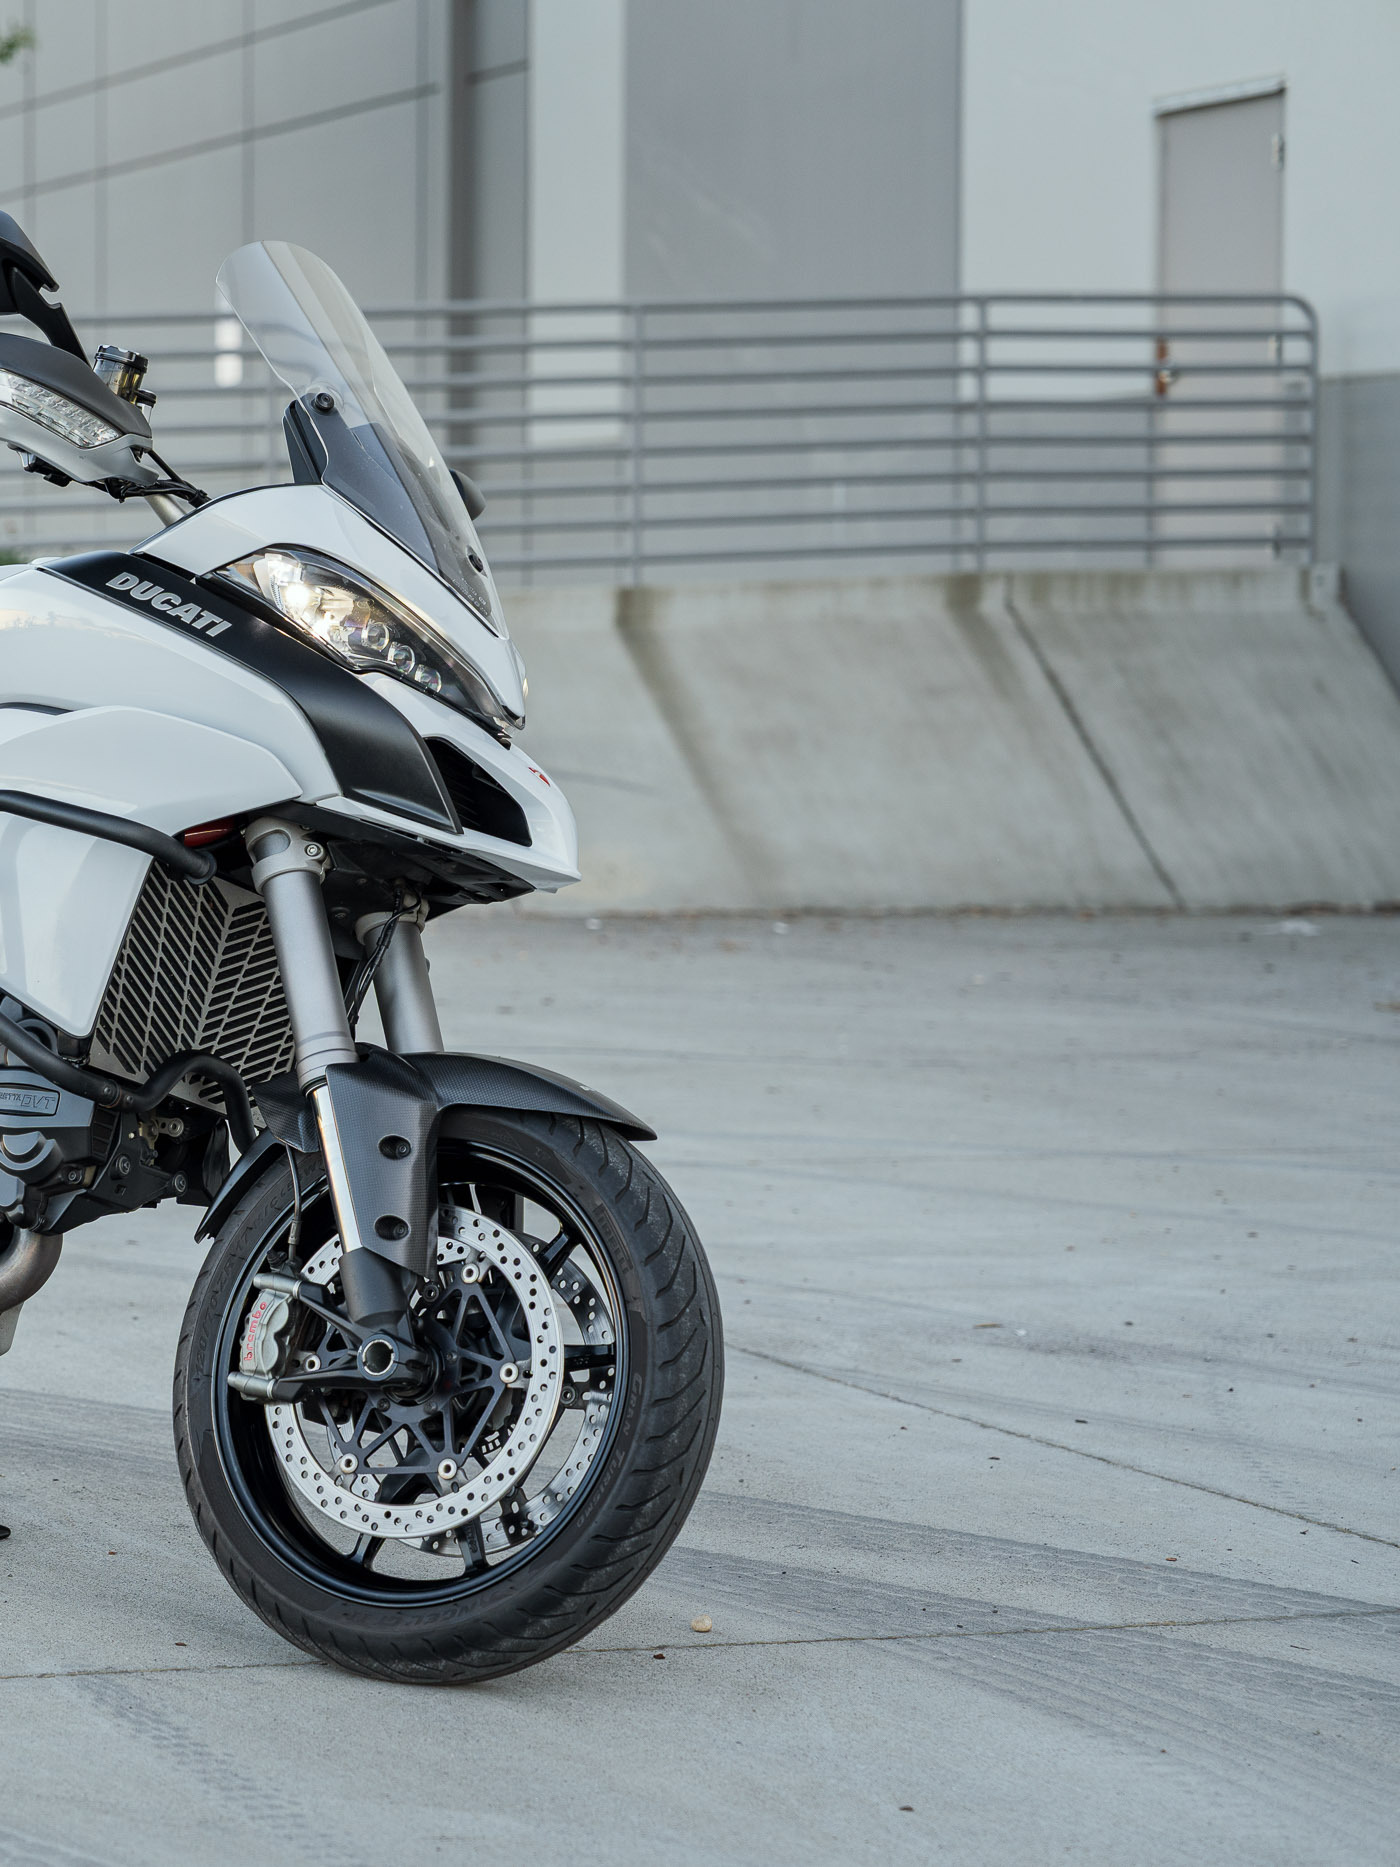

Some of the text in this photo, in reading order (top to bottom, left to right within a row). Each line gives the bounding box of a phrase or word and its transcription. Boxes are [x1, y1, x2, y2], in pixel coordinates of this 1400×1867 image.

[105, 571, 233, 637] DUCATI
[20, 1094, 56, 1110] DVT
[244, 1301, 268, 1362] brembo
